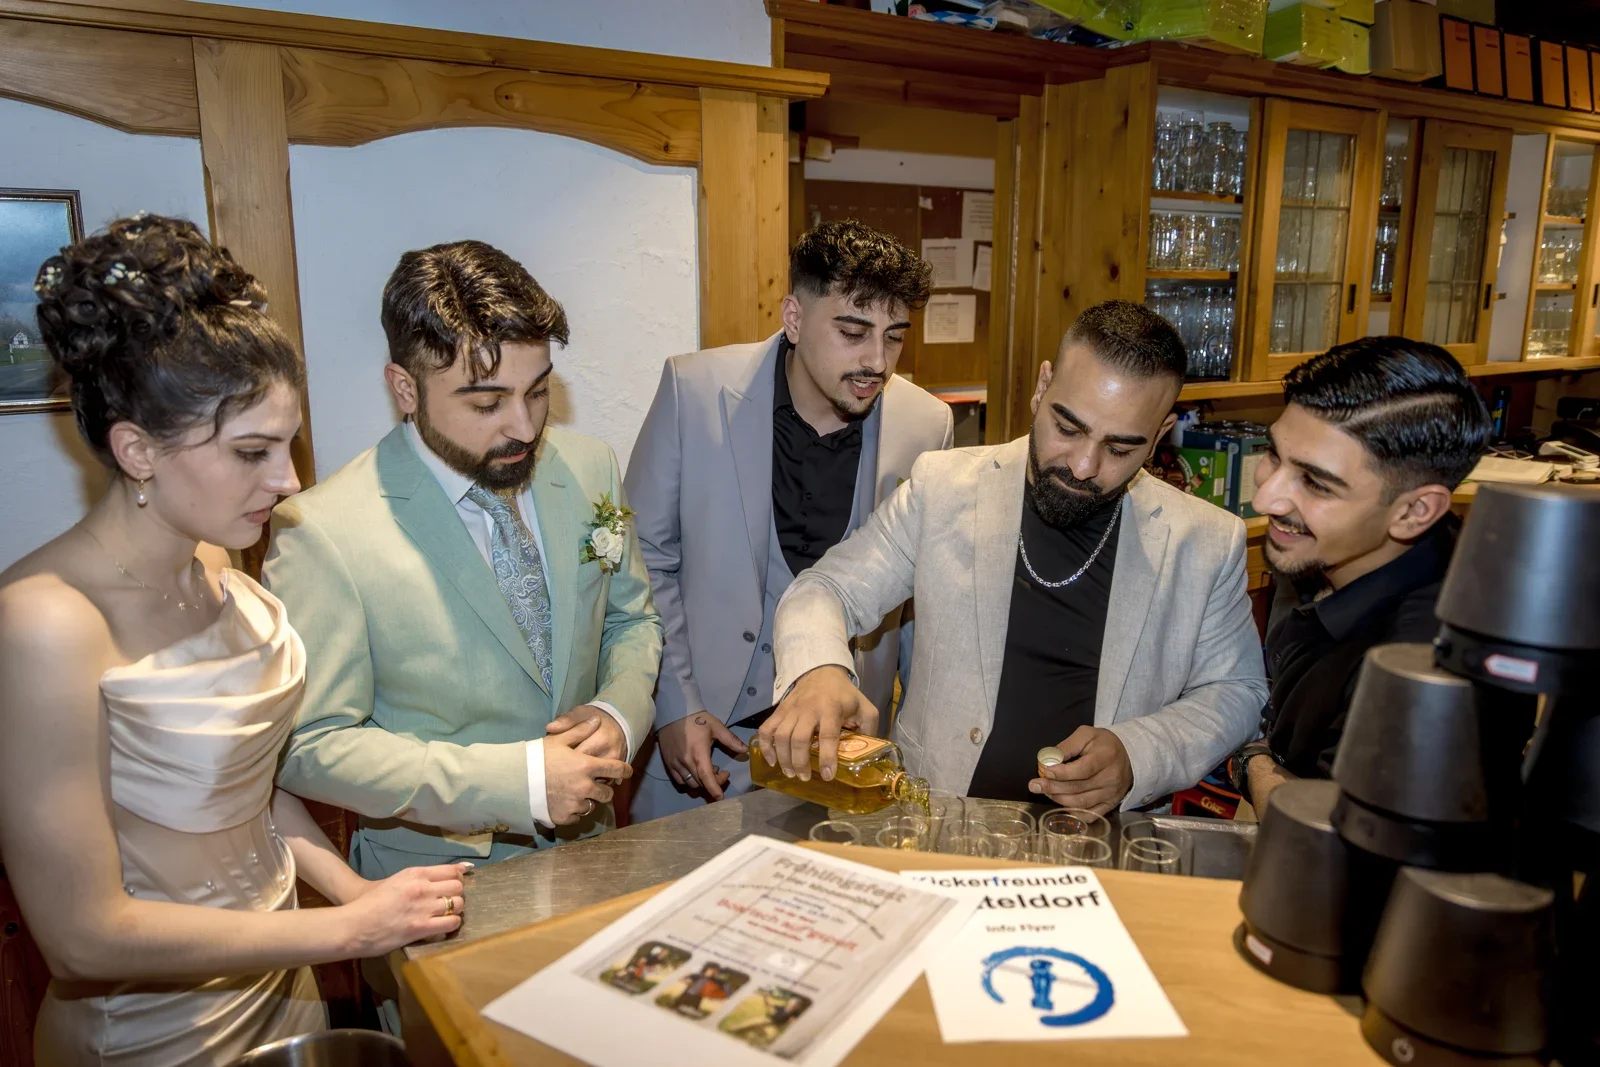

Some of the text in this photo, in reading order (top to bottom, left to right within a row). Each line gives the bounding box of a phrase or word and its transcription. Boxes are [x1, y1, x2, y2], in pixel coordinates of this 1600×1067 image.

[912, 873, 1088, 889] ickerfreunde
[977, 890, 1100, 909] teldorf
[986, 923, 1056, 933] Info Flyer
